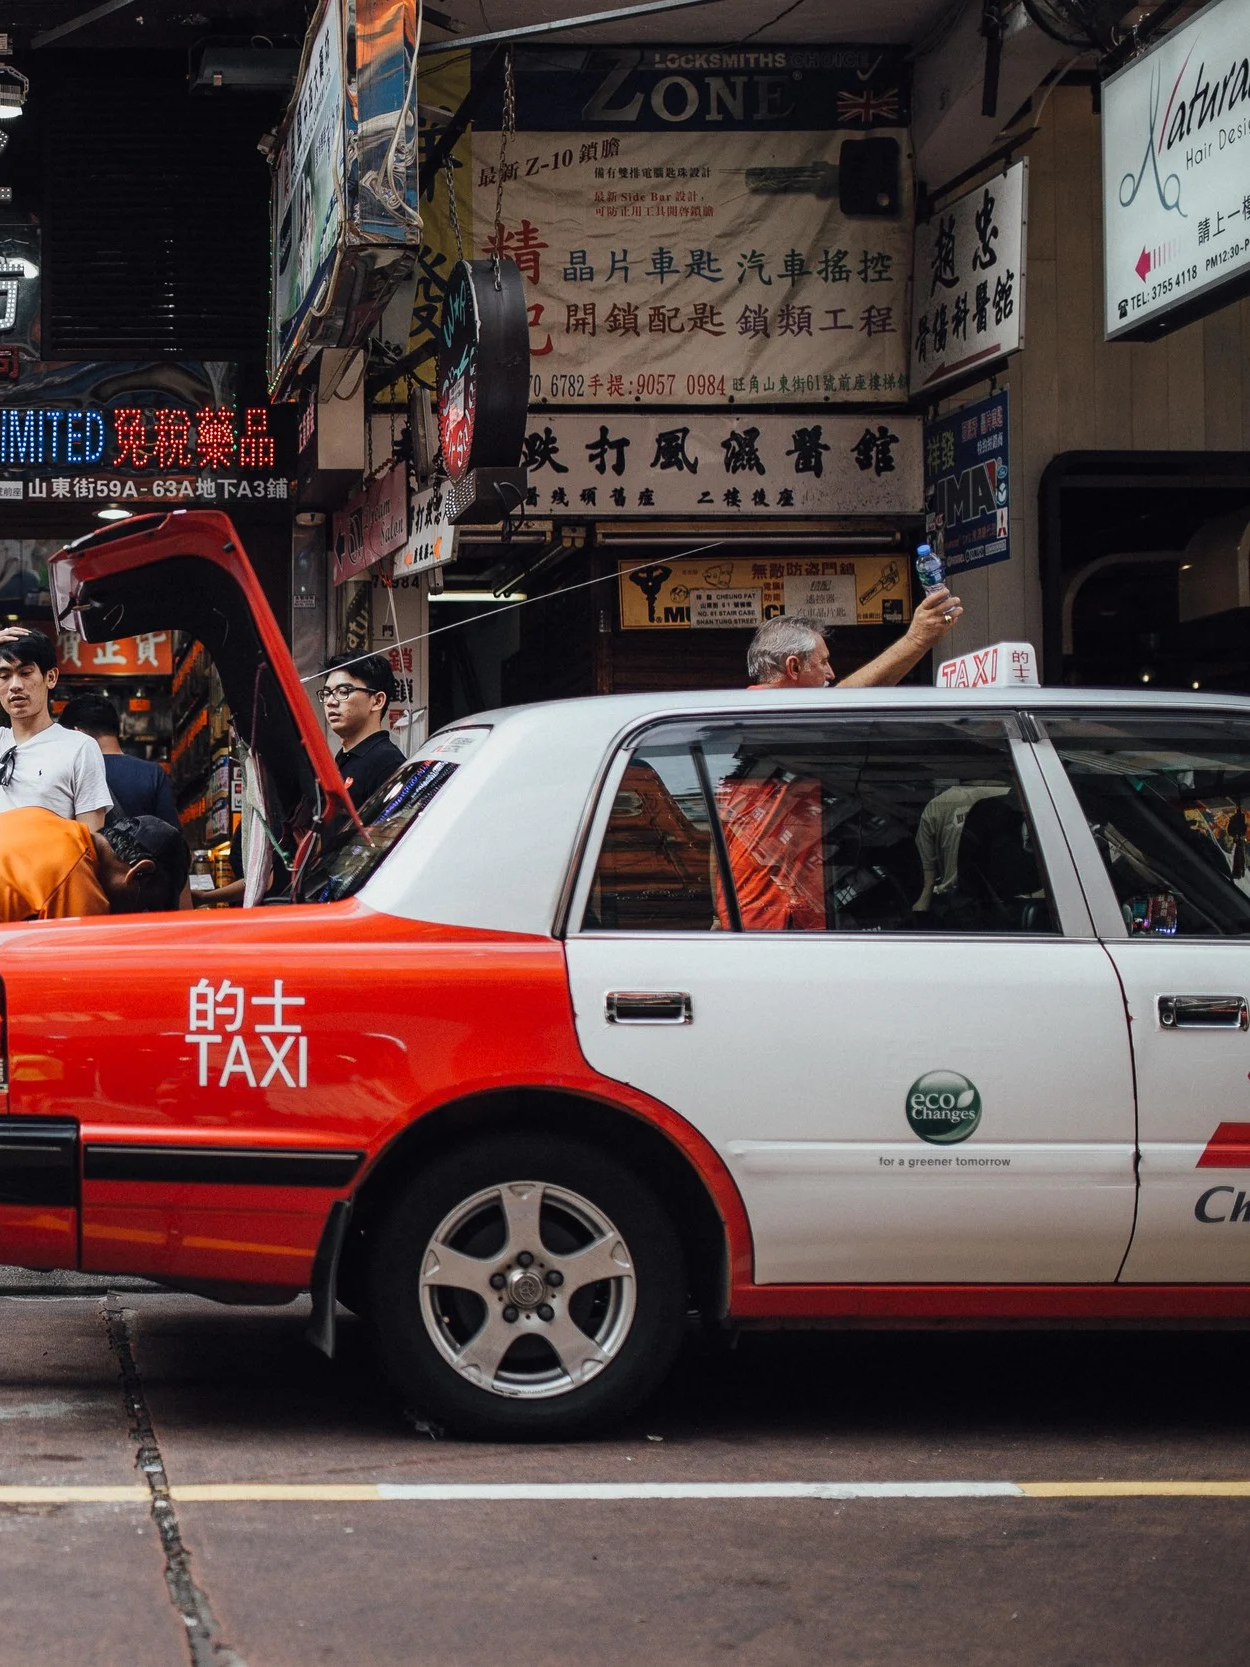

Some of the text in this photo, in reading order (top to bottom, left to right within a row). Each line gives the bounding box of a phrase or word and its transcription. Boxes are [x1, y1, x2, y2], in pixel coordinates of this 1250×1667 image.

[654, 52, 870, 70] LOCKSMITHS CHOICE
[525, 148, 574, 177] Z-10
[1186, 142, 1213, 170] Hair
[620, 192, 646, 202] Side
[651, 192, 672, 202] Bar
[563, 248, 724, 286] 晶片車匙
[1130, 263, 1198, 311] TEL: 3755 4118
[565, 302, 726, 338] 開鎖配匙
[551, 375, 584, 397] 6782
[687, 374, 727, 397] 0984
[732, 617, 758, 626] STREET
[942, 648, 1031, 688] TAXI 的士
[189, 977, 306, 1034] 的士
[184, 1034, 308, 1088] TAXI
[910, 1093, 956, 1110] eco
[911, 1106, 976, 1124] Changes
[879, 1156, 1011, 1169] for a greener tomorrow
